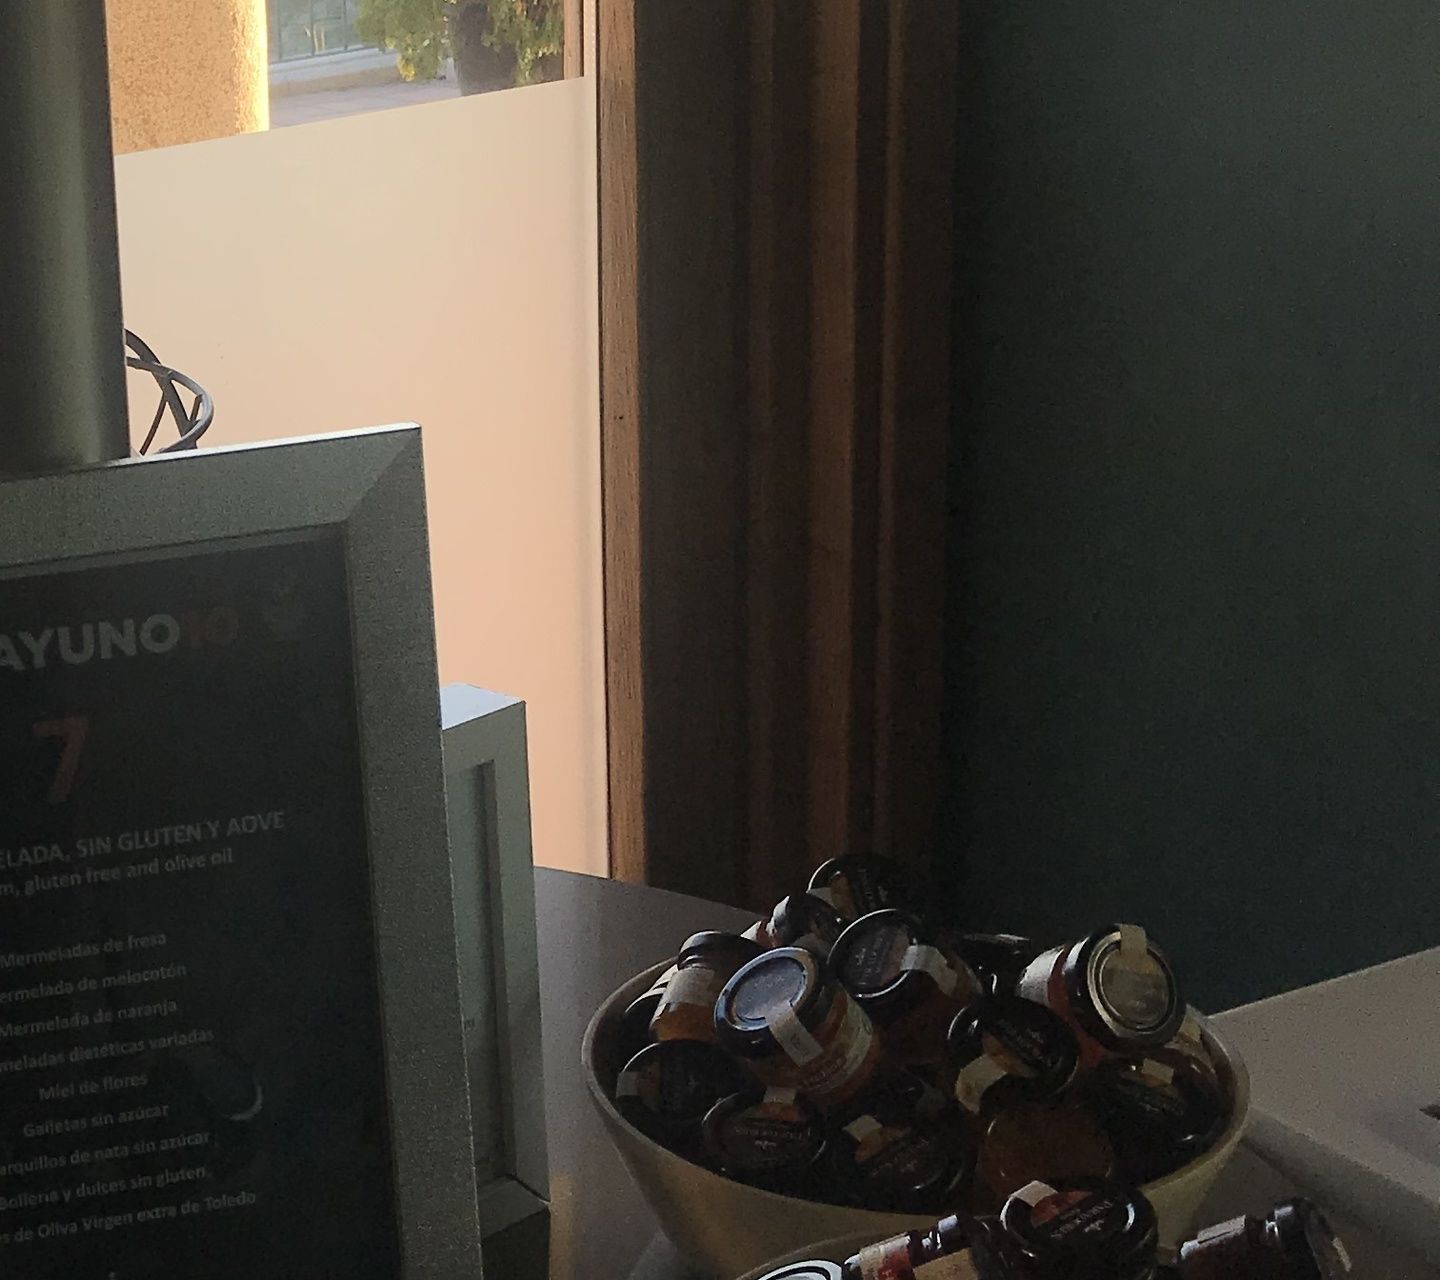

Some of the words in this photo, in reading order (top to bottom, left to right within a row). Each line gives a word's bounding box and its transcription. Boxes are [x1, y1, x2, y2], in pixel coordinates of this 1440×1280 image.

[31, 716, 90, 804] 7
[76, 836, 112, 860] SIN
[116, 823, 204, 852] GLUTEN
[206, 819, 220, 839] Y
[25, 869, 81, 897] gluten
[85, 862, 121, 884] free
[126, 856, 159, 878] and
[163, 851, 206, 874] olive
[210, 846, 234, 867] oil
[0, 942, 100, 969] Mermeladas
[103, 937, 123, 953] de
[127, 931, 167, 949] fresa
[77, 975, 98, 991] de
[93, 1007, 114, 1023] de
[117, 999, 178, 1022] naranja
[68, 1037, 146, 1062] dietéticas
[148, 1027, 214, 1050] variadas
[38, 1082, 75, 1101] Miel
[79, 1078, 100, 1095] de
[103, 1072, 148, 1090] flores
[23, 1116, 88, 1138] Galletas
[91, 1111, 115, 1127] sin
[118, 1103, 170, 1124] azúcar
[70, 1147, 91, 1163] de
[94, 1142, 129, 1161] nata
[132, 1138, 157, 1155] sin
[160, 1129, 210, 1151] azúcar
[62, 1188, 73, 1204] y
[75, 1178, 127, 1199] dulces
[130, 1173, 153, 1190] sin
[155, 1165, 207, 1188] gluten
[14, 1225, 34, 1243] de
[37, 1220, 79, 1240] Oliva
[81, 1213, 134, 1234] Virgen
[136, 1205, 177, 1223] extra
[180, 1199, 200, 1215] de
[204, 1190, 257, 1211] Toledo
